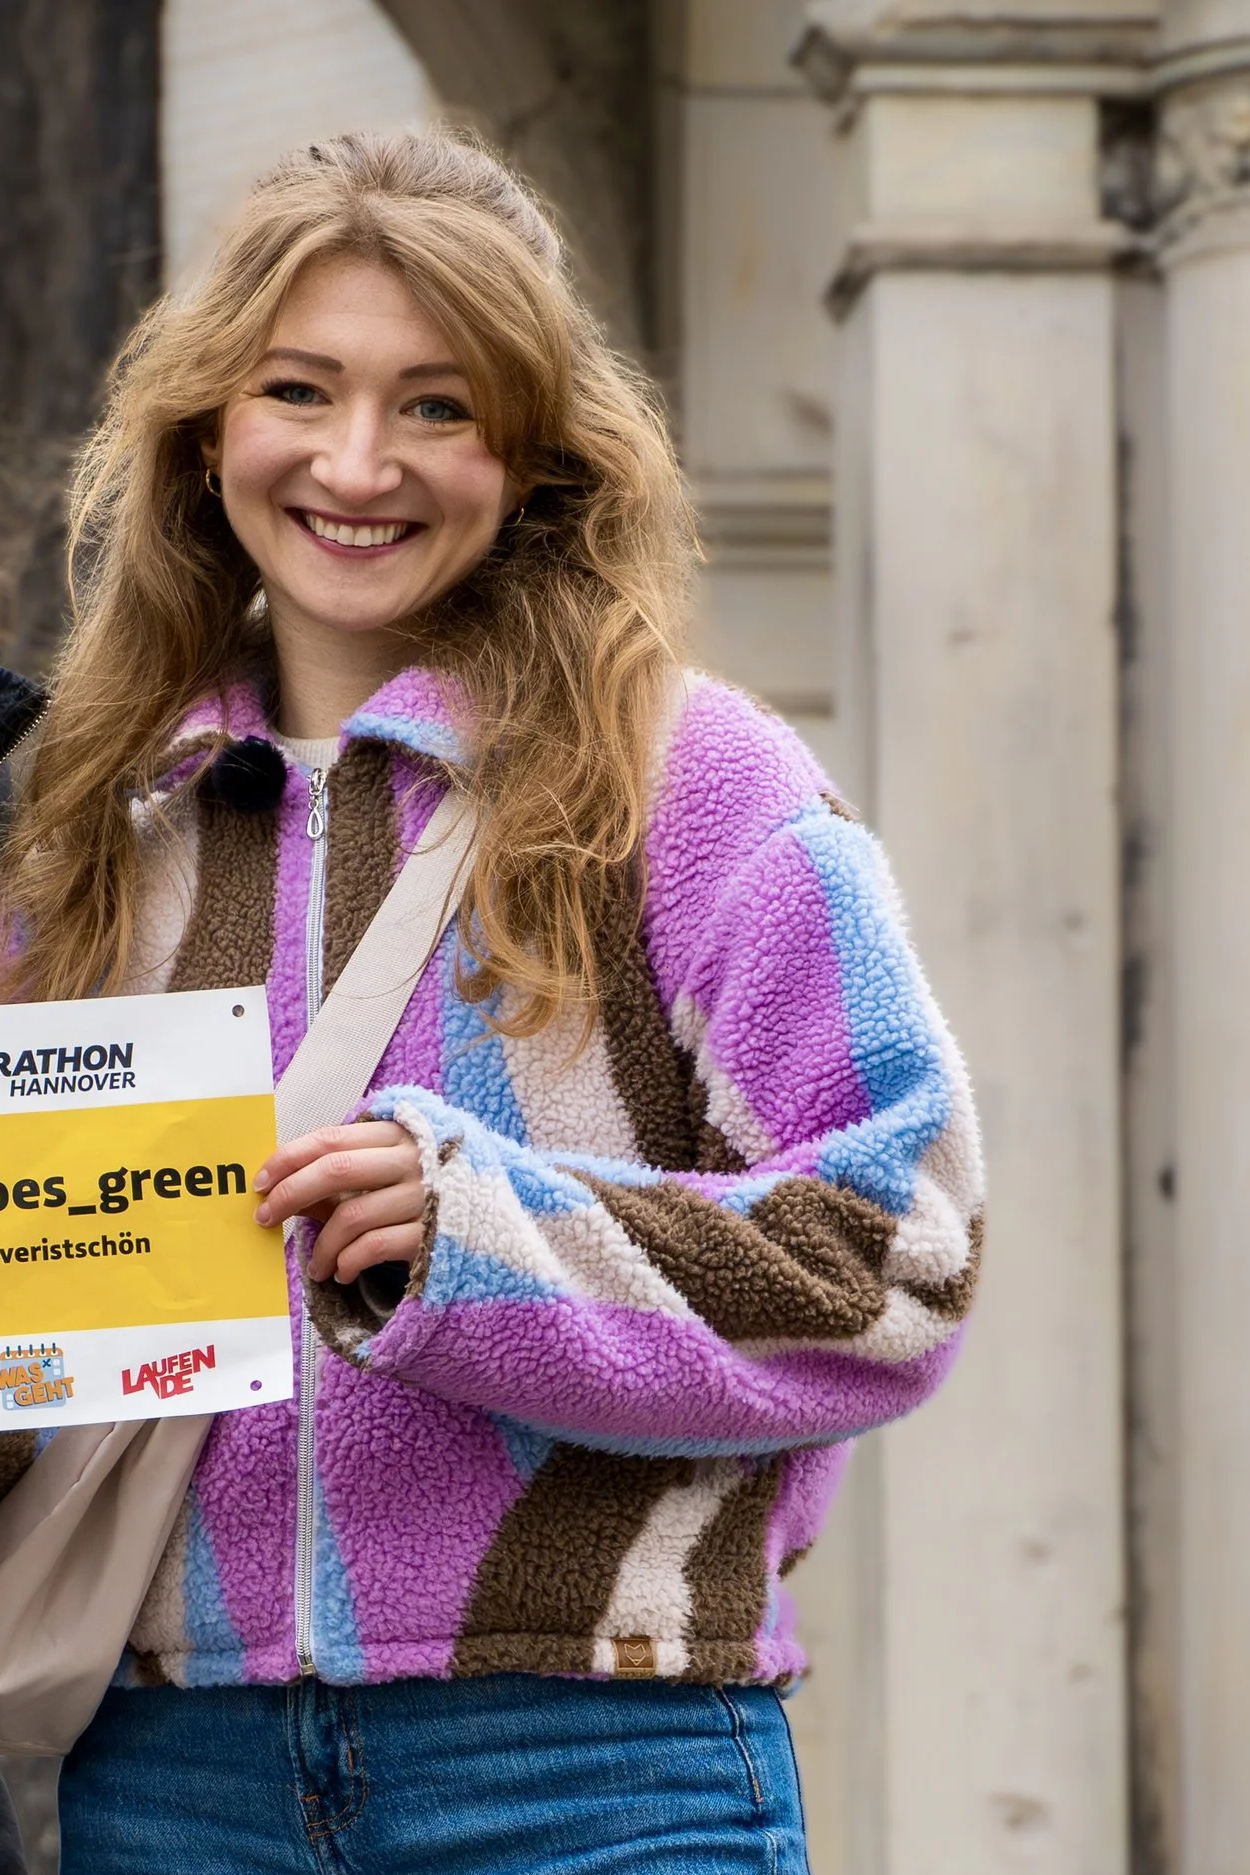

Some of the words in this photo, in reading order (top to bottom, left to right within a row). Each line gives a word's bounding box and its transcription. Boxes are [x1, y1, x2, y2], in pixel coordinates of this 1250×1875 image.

[10, 1071, 136, 1097] HANNOVER
[121, 1344, 216, 1399] LAUFEN
[159, 1369, 194, 1400] DE
[14, 1377, 75, 1407] GEHT
